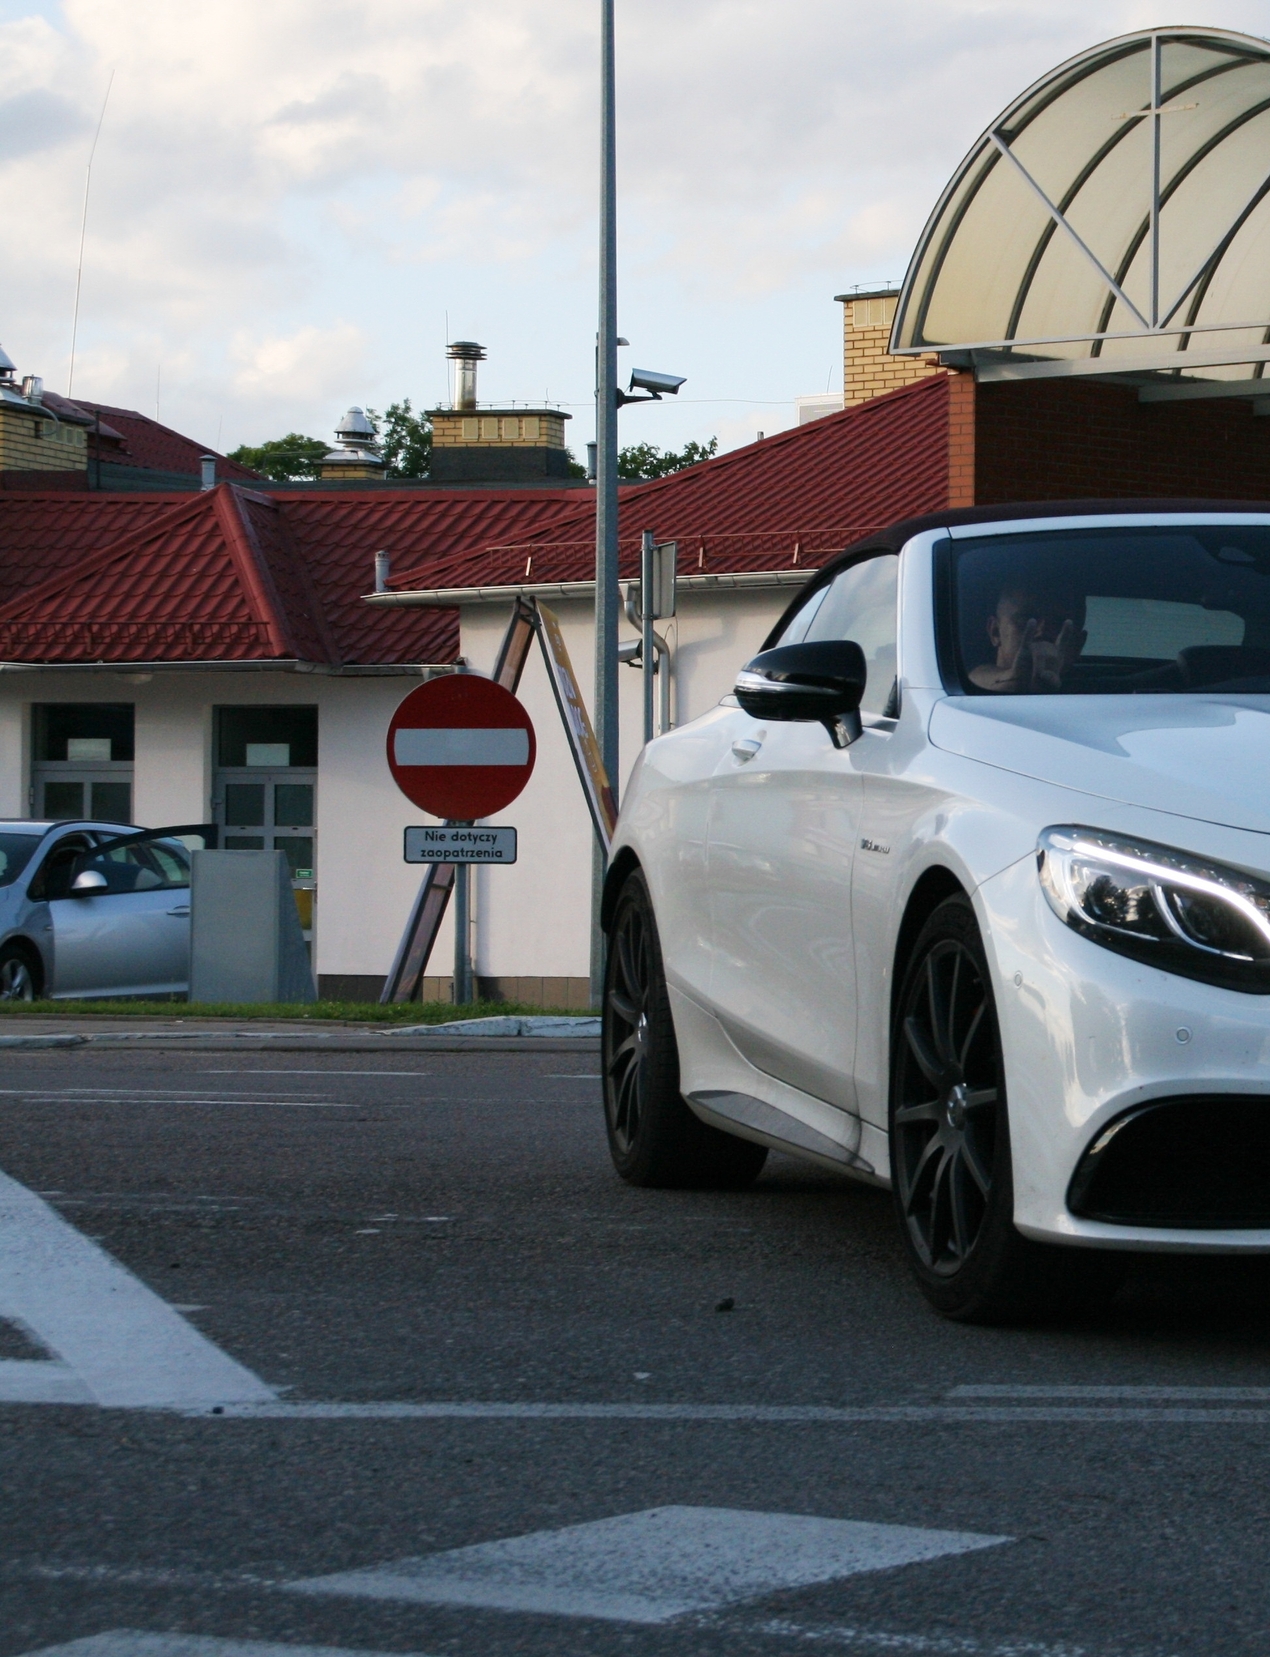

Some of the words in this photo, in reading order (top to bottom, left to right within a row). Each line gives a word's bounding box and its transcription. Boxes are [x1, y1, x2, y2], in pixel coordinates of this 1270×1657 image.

[424, 830, 447, 842] Nie
[451, 830, 498, 845] dotyczy
[420, 847, 503, 861] zaopatrzenia
